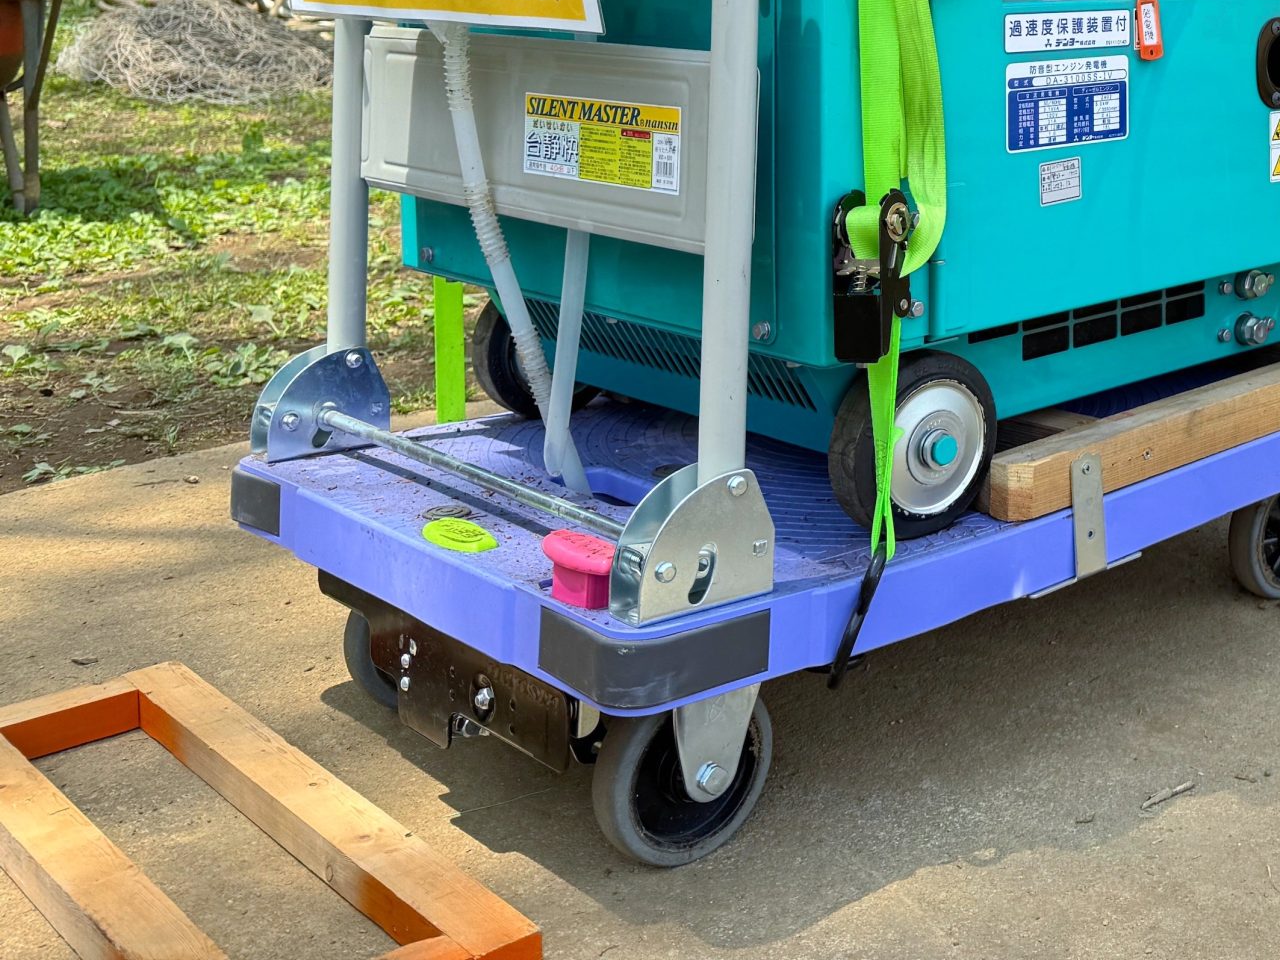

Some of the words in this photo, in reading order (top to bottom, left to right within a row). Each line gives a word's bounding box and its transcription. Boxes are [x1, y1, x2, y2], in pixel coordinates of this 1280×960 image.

[1009, 15, 1127, 37] 過速度保護装置付
[1029, 59, 1108, 75] 防音型エンジン発電機
[1045, 71, 1113, 86] DA-3100SS-IV
[527, 96, 579, 119] SILENT
[578, 101, 641, 127] MASTER
[644, 118, 679, 131] nansin
